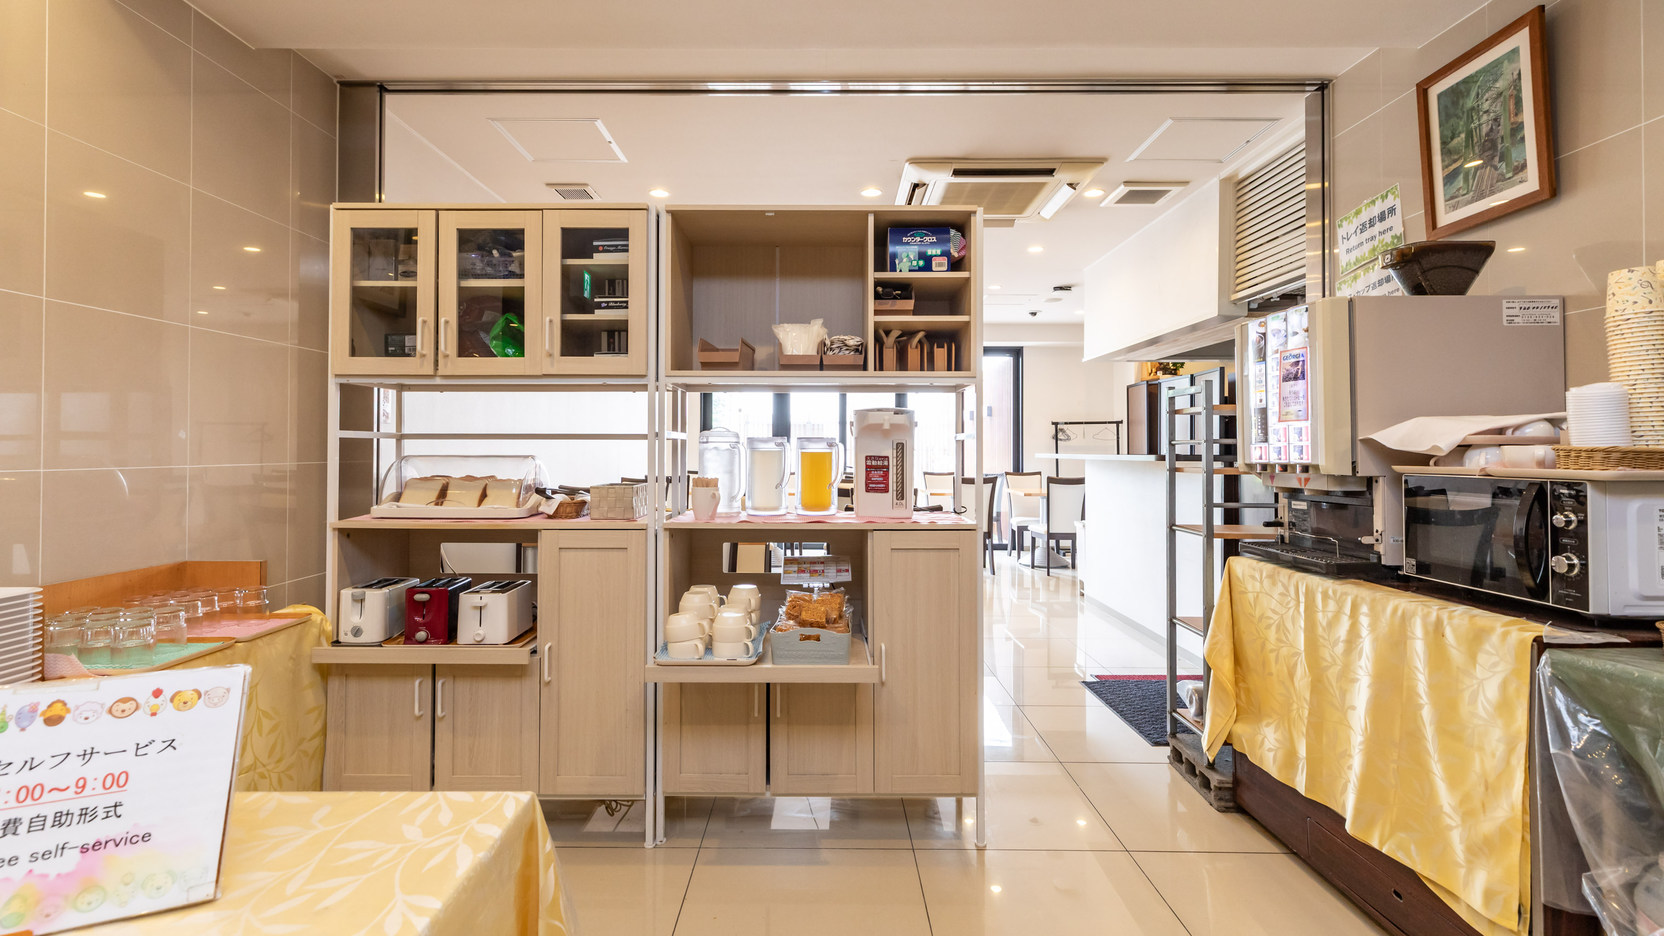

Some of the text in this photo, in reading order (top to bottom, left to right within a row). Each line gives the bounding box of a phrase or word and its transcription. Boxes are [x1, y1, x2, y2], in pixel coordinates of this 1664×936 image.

[1341, 204, 1397, 245] トレイ返却場所
[1345, 225, 1394, 255] Return tray here
[1282, 353, 1305, 361] GEORGIA
[0, 771, 129, 805] :00～9:00
[0, 801, 124, 839] 費自助形式
[28, 832, 153, 864] self-service
